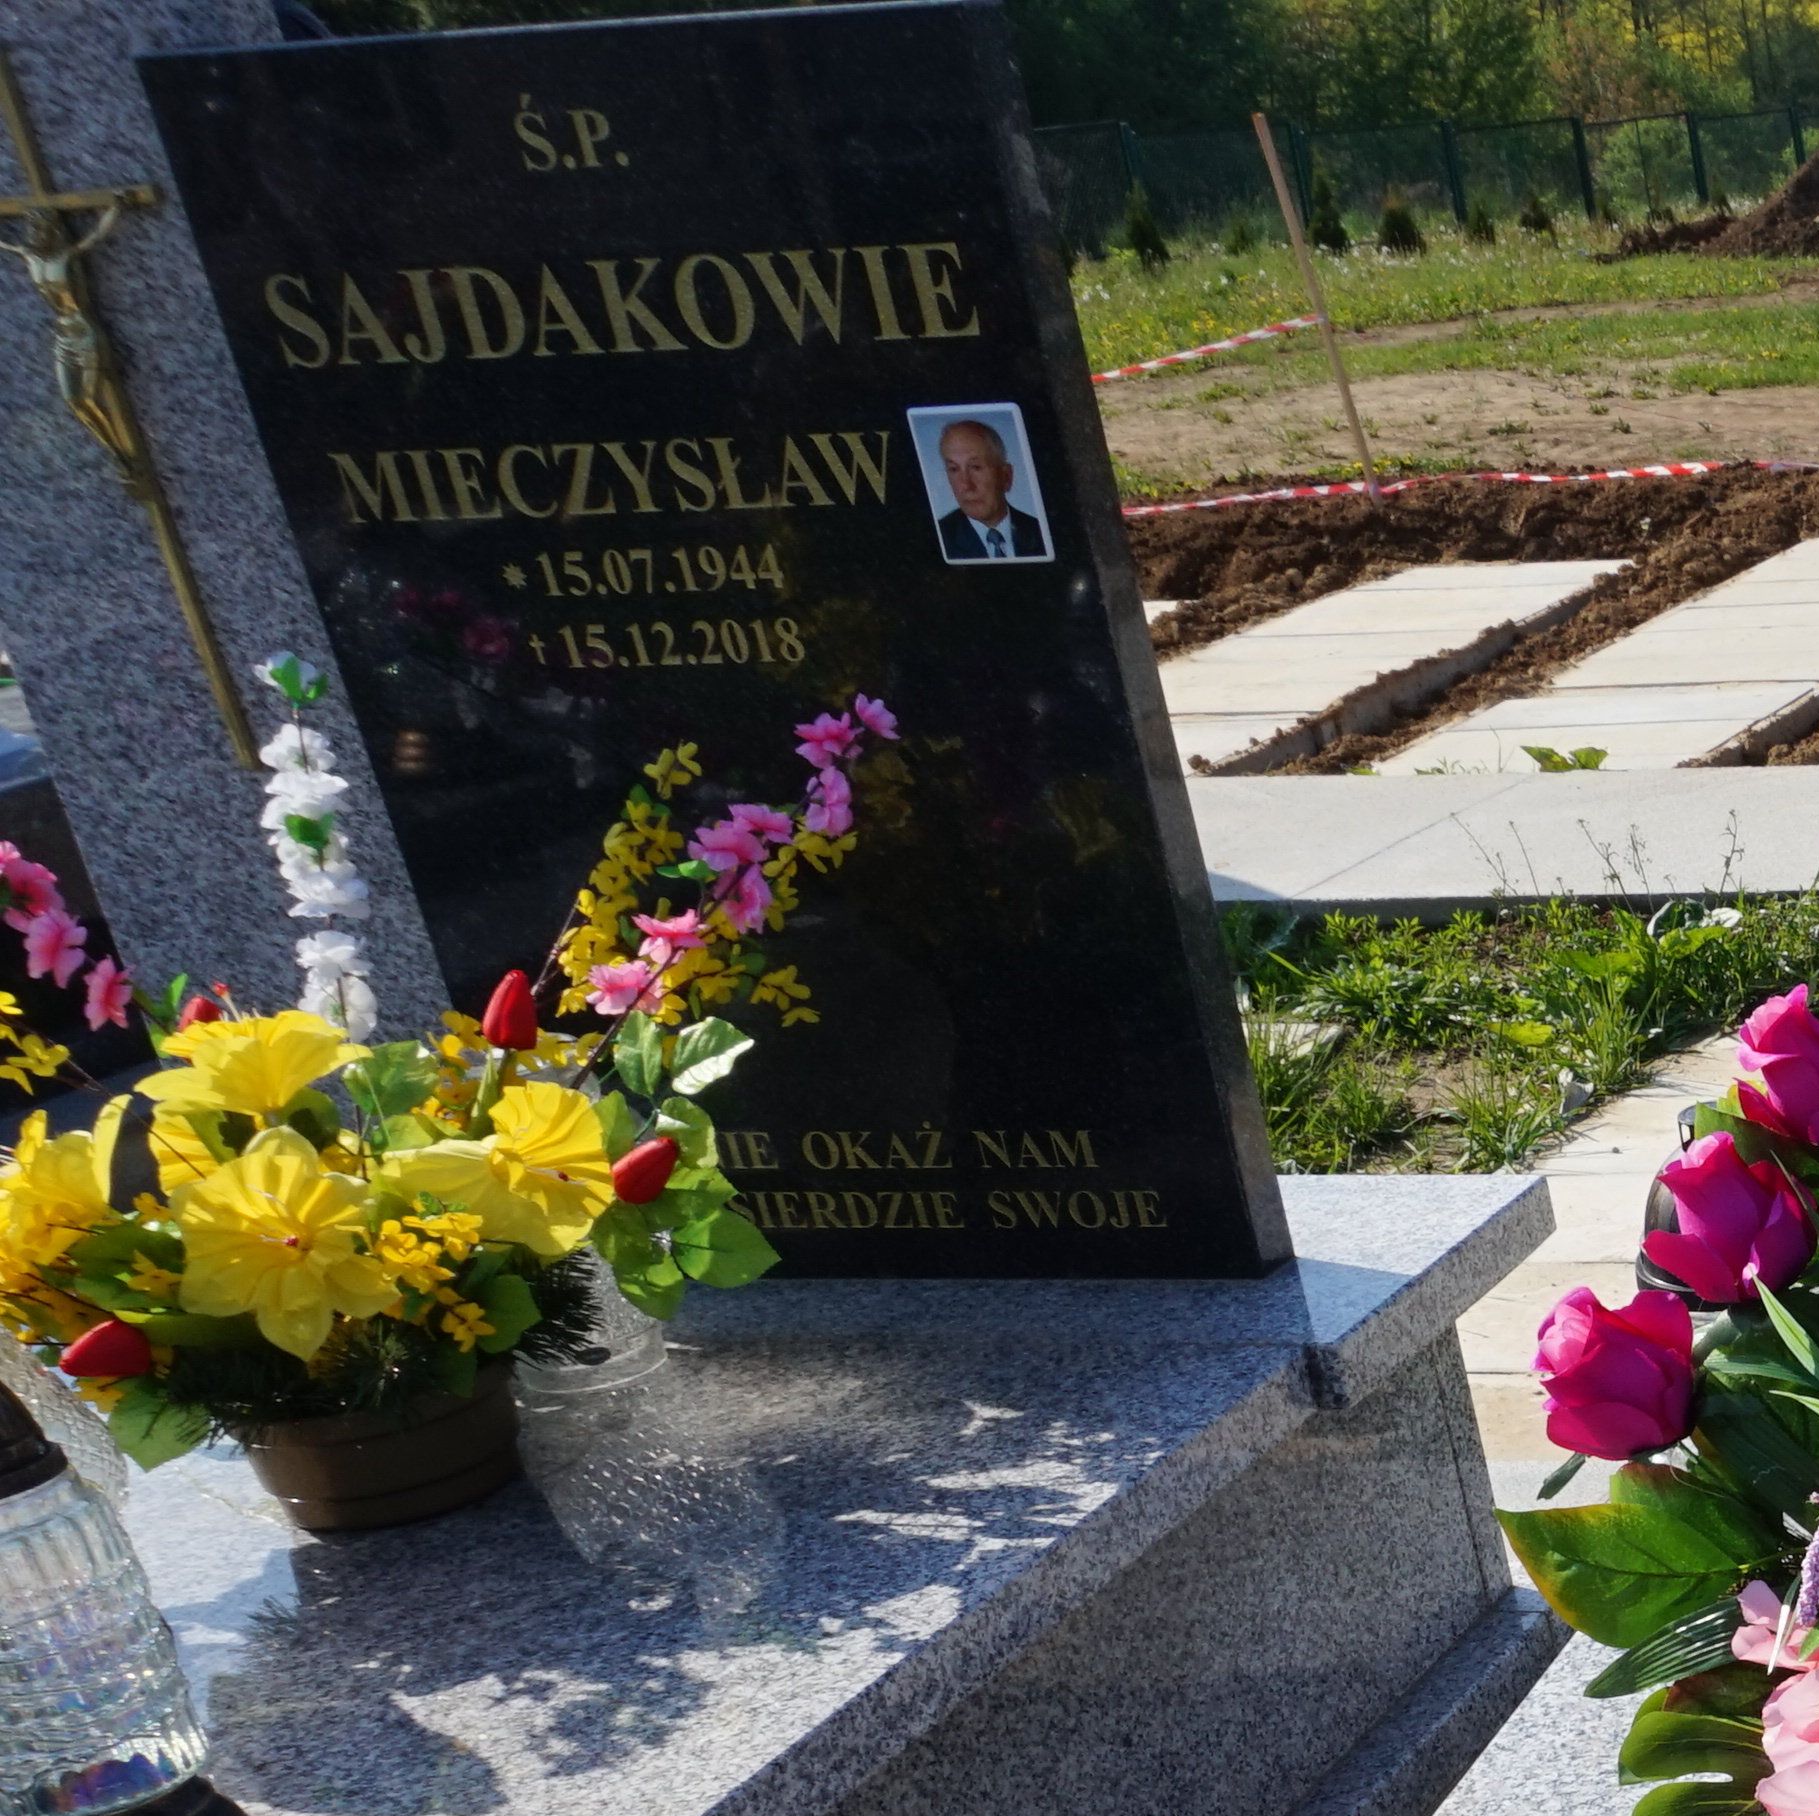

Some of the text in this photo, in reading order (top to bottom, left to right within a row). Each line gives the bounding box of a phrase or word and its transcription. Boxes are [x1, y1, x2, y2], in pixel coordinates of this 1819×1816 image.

[514, 92, 630, 171] Ś.P.
[264, 241, 981, 369] SAJDAKOWIE
[327, 431, 892, 524] MIECZYSŁAW
[718, 1121, 1100, 1170] IE OKAŻ NAM
[992, 1188, 1168, 1229] SWOJE
